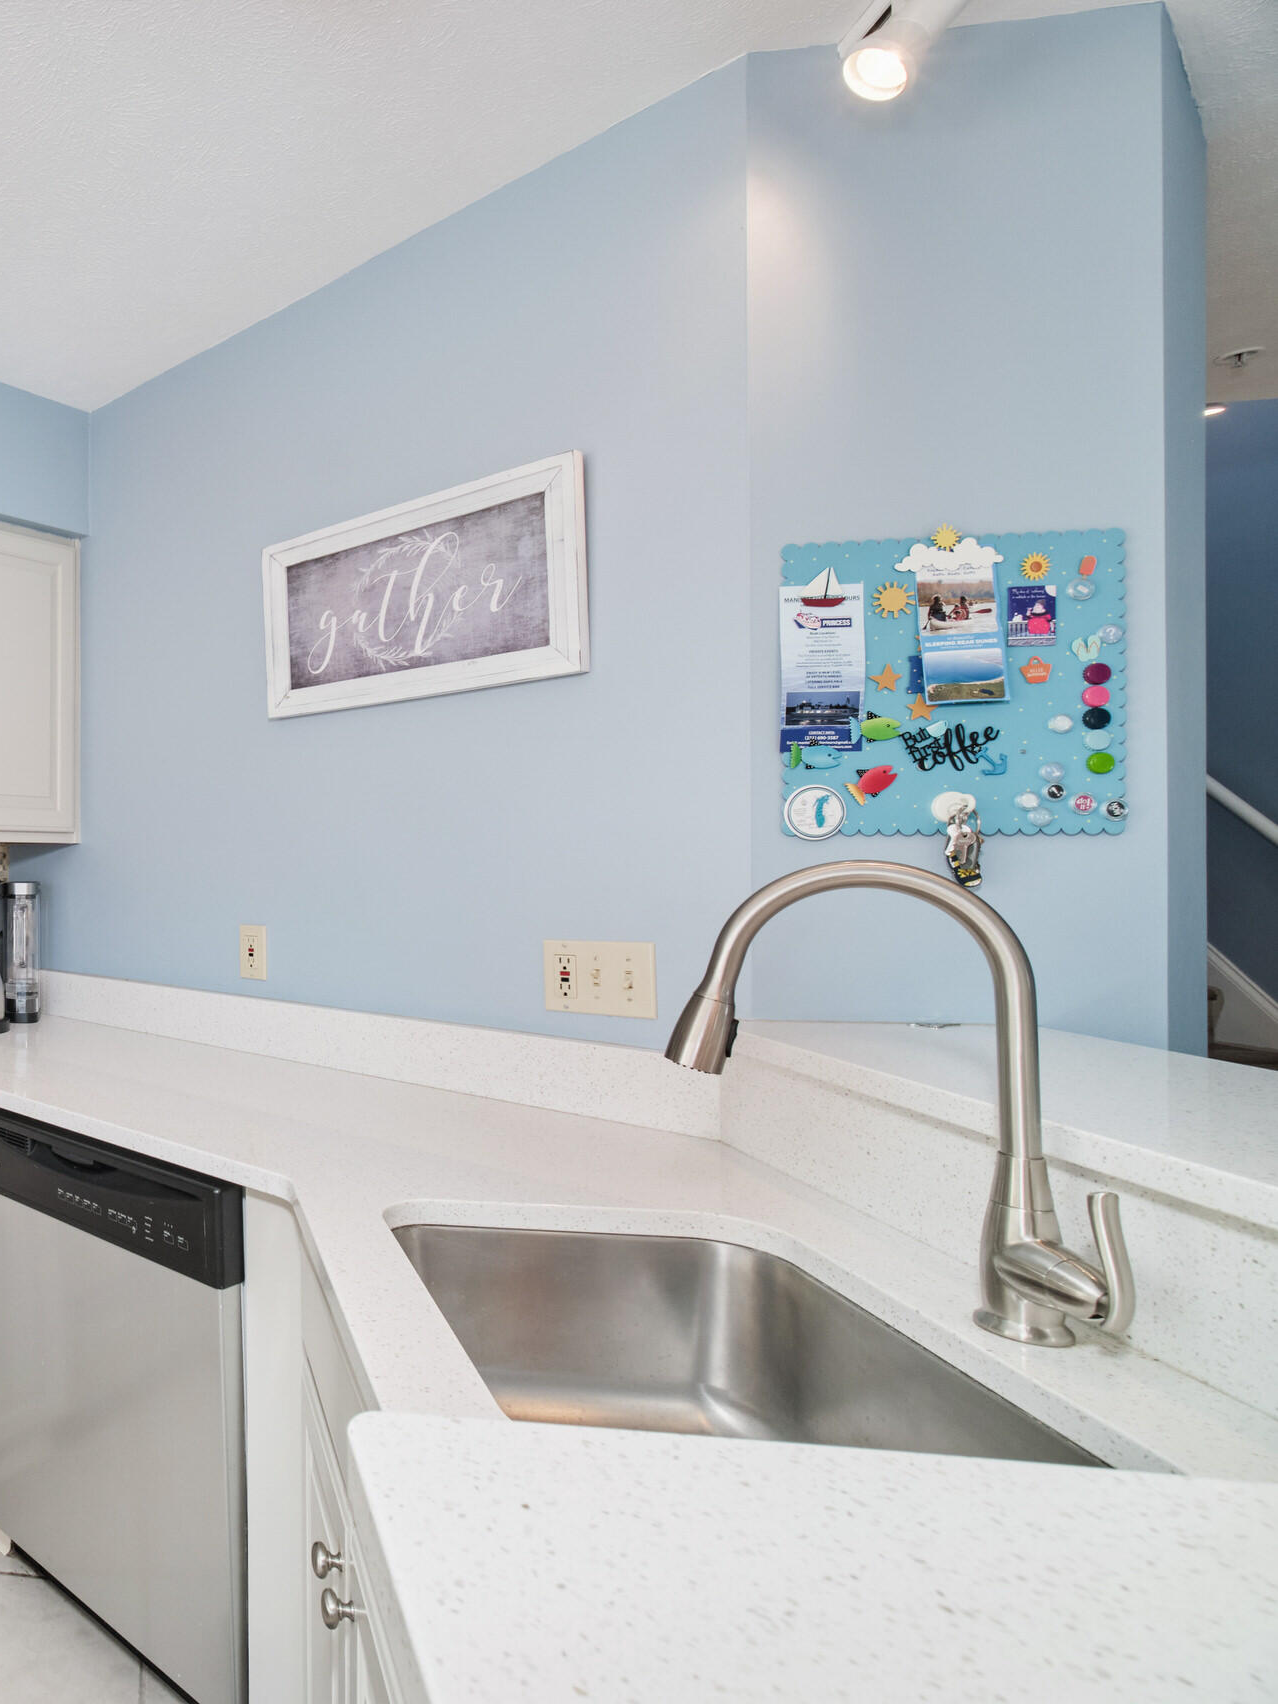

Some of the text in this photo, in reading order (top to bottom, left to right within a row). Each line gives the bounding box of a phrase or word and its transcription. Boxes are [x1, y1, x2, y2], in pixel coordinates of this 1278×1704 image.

[307, 531, 523, 674] gather
[822, 618, 851, 627] PRINCESS
[918, 723, 1000, 772] coffee
